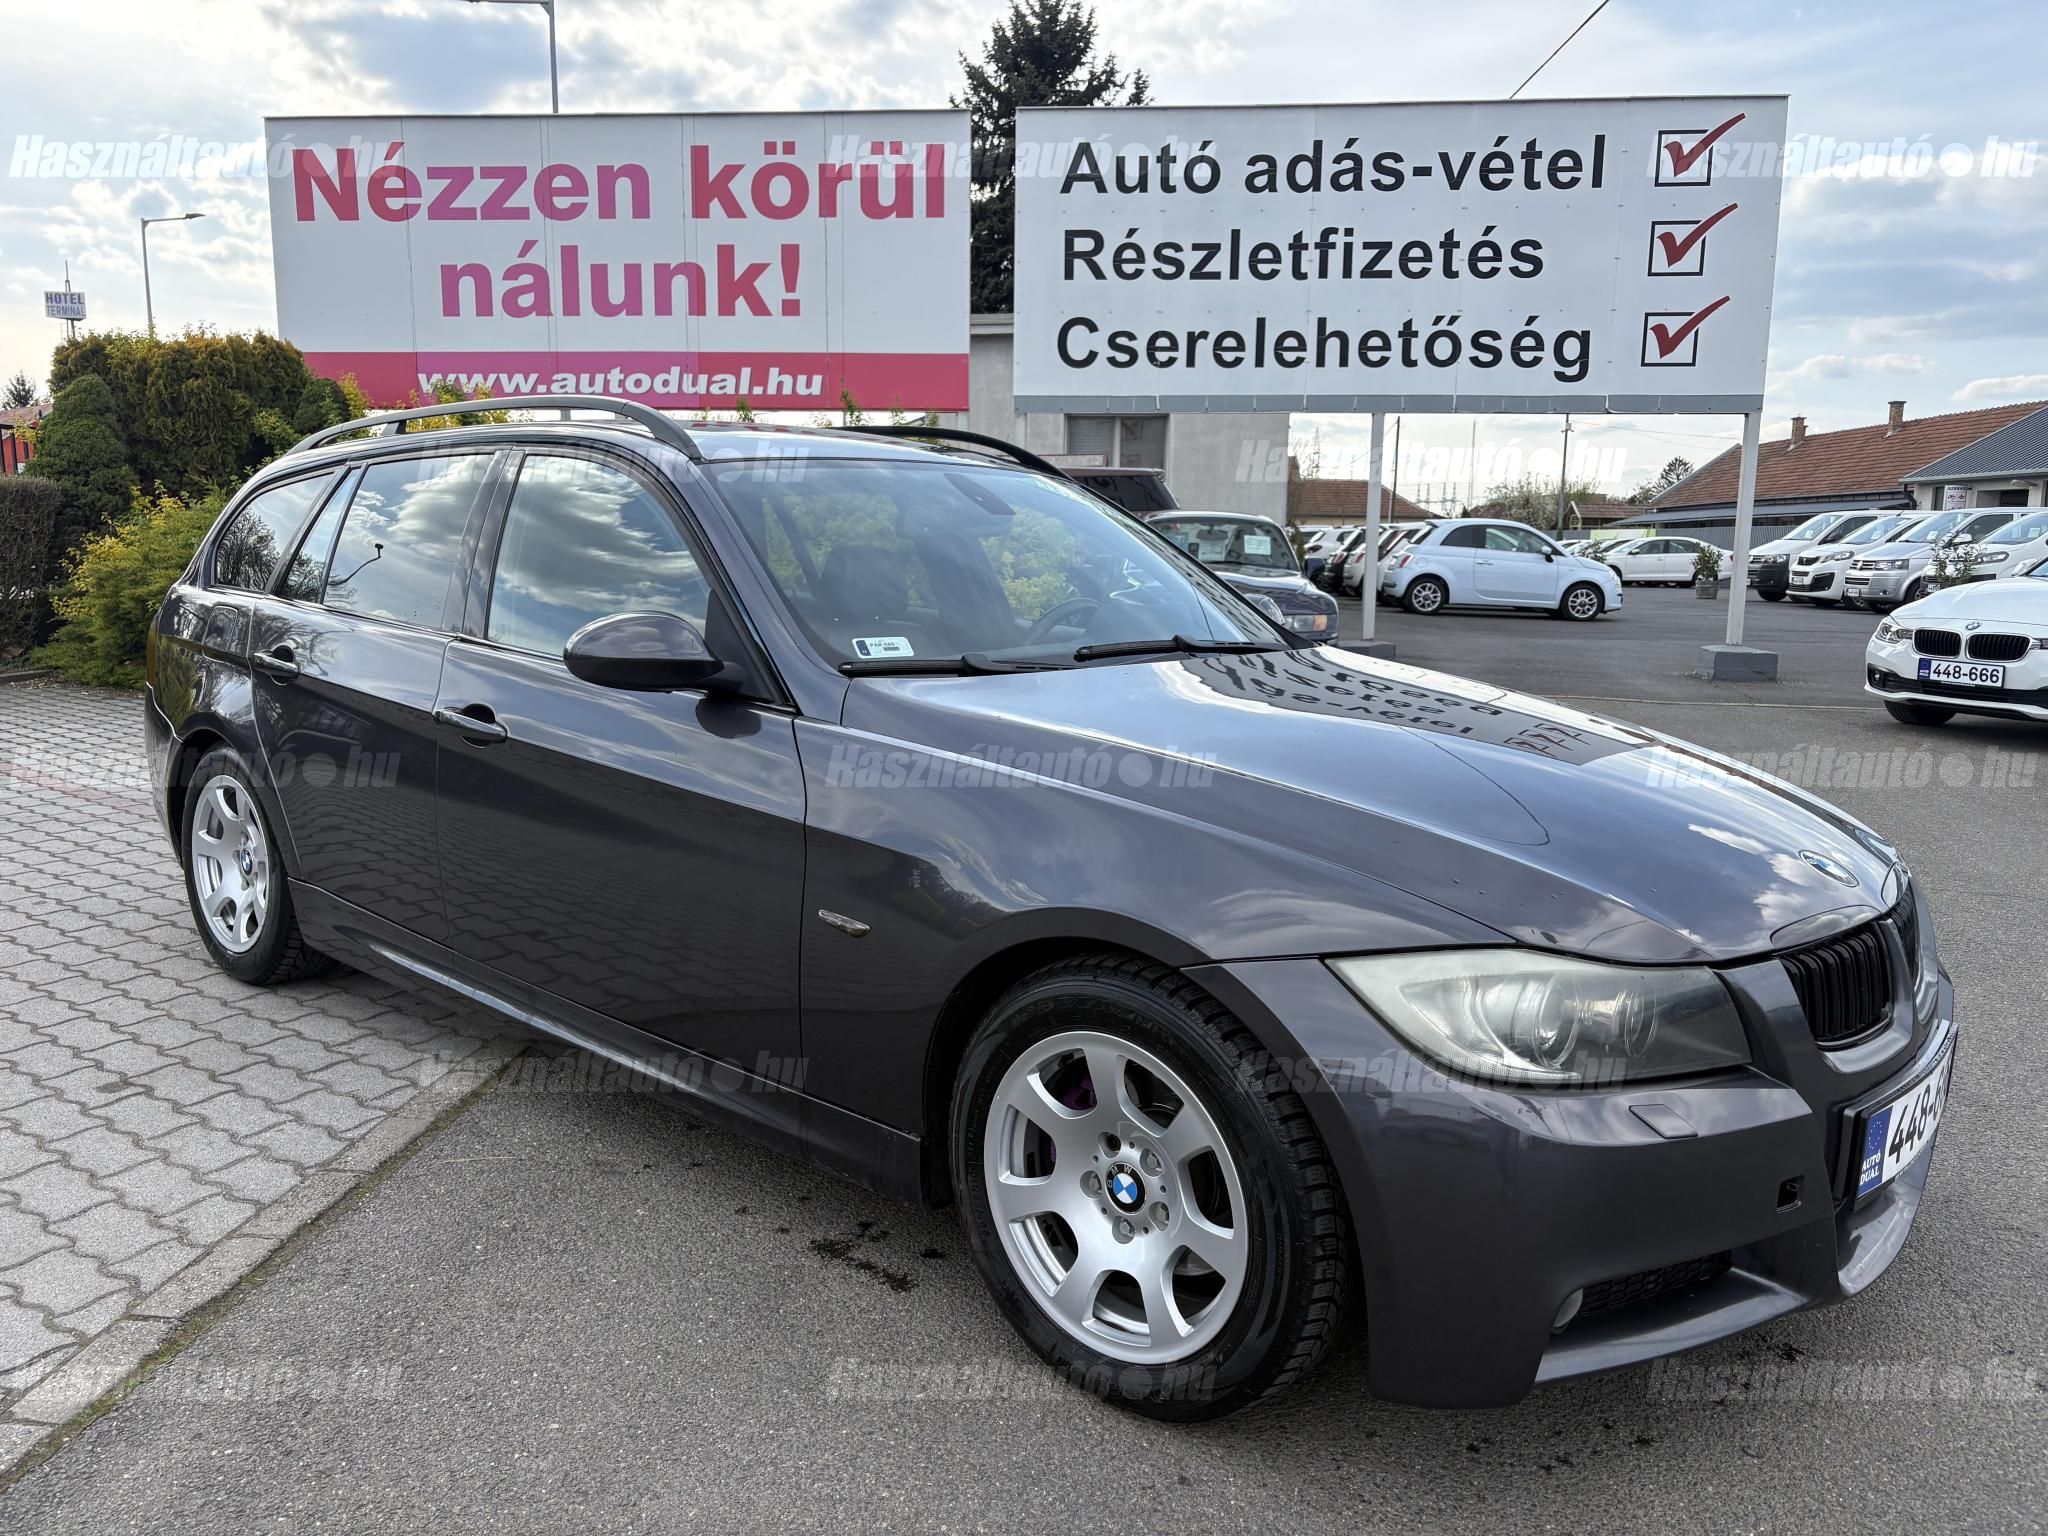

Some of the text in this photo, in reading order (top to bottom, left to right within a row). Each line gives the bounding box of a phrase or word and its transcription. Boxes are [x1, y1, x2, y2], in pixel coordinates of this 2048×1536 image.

[1060, 134, 1606, 195] Autó adás-vétel
[293, 140, 945, 222] Nézzen körül
[1064, 225, 1544, 281] Részletfizetés
[441, 239, 800, 318] nálunk!
[45, 292, 85, 305] HOTEL
[46, 304, 86, 317] TERMINAL
[1057, 314, 1591, 383] Cserelehetőség
[418, 366, 823, 396] www.autodual.hu
[1932, 663, 2000, 684] 448-666
[1862, 1149, 1881, 1172] AUTÓ
[1106, 1164, 1132, 1189] BMW
[1860, 1166, 1880, 1185] DUAL
